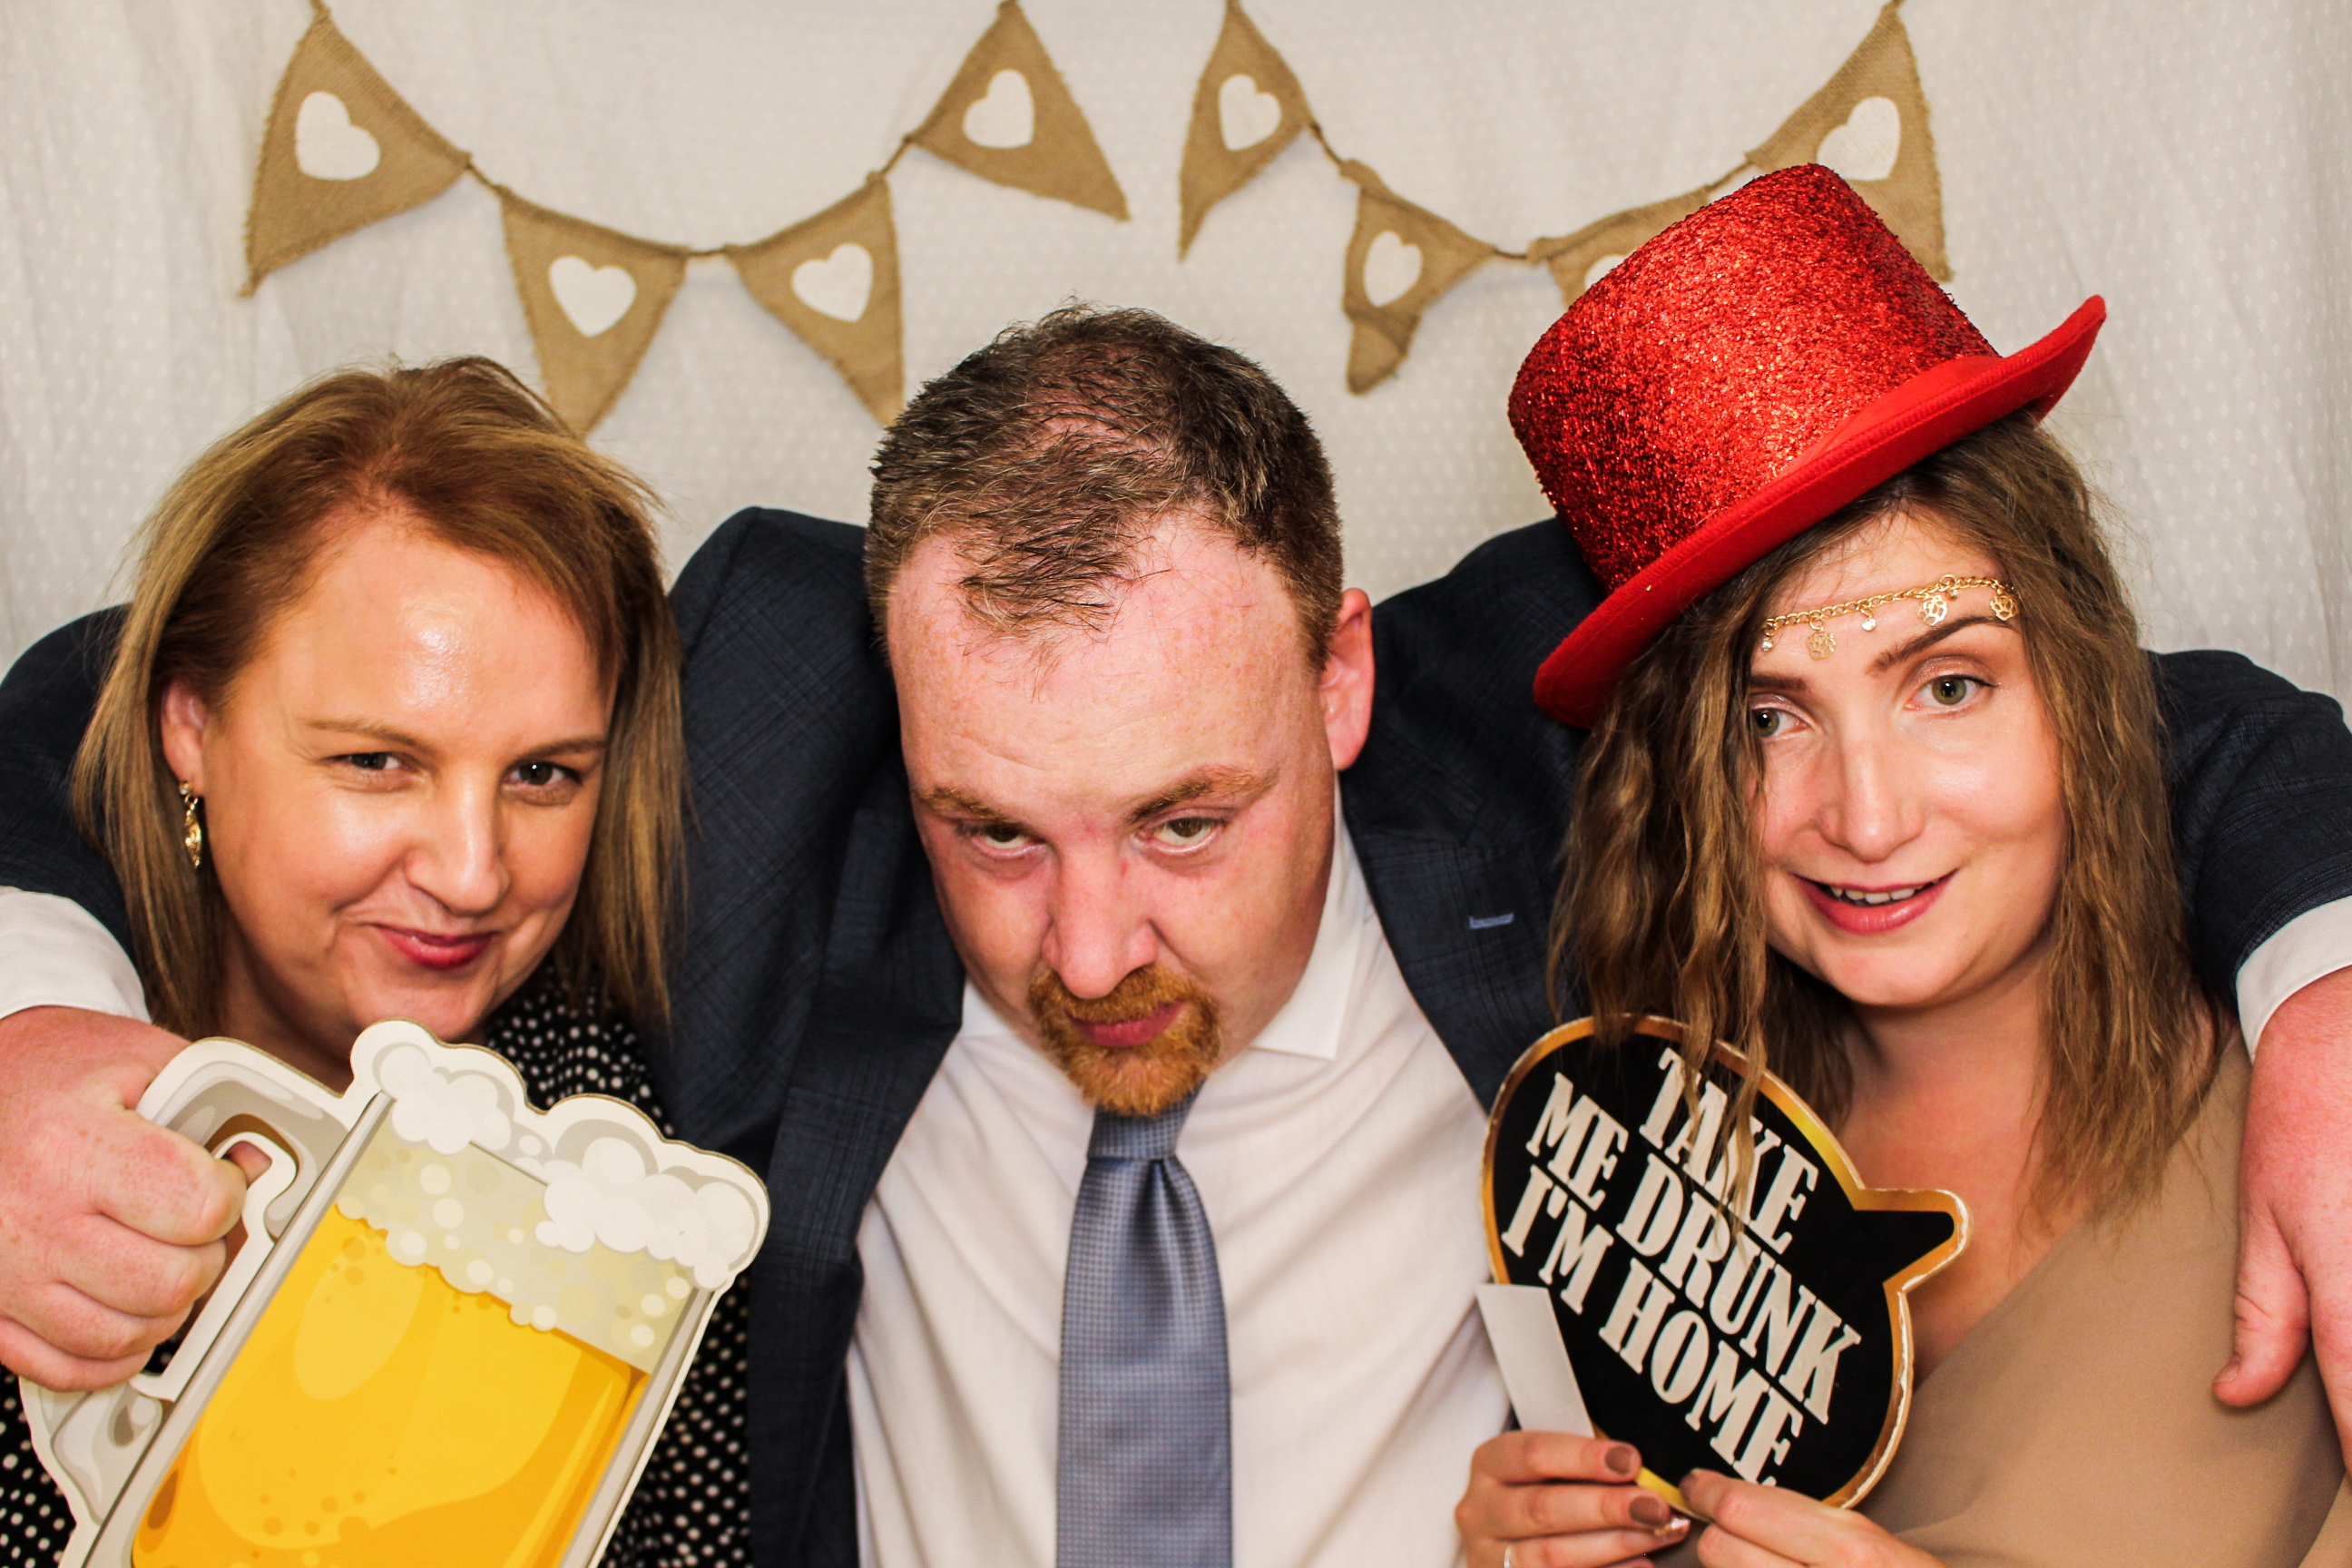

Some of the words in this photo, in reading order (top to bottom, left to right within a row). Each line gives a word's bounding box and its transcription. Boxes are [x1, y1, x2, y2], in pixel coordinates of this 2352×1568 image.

[1526, 1072, 1629, 1211] ME
[1616, 1152, 1861, 1425] DRUNK
[1640, 1047, 1818, 1254] TAKE
[1502, 1165, 1613, 1315] I'M
[1599, 1258, 1803, 1486] HOME
